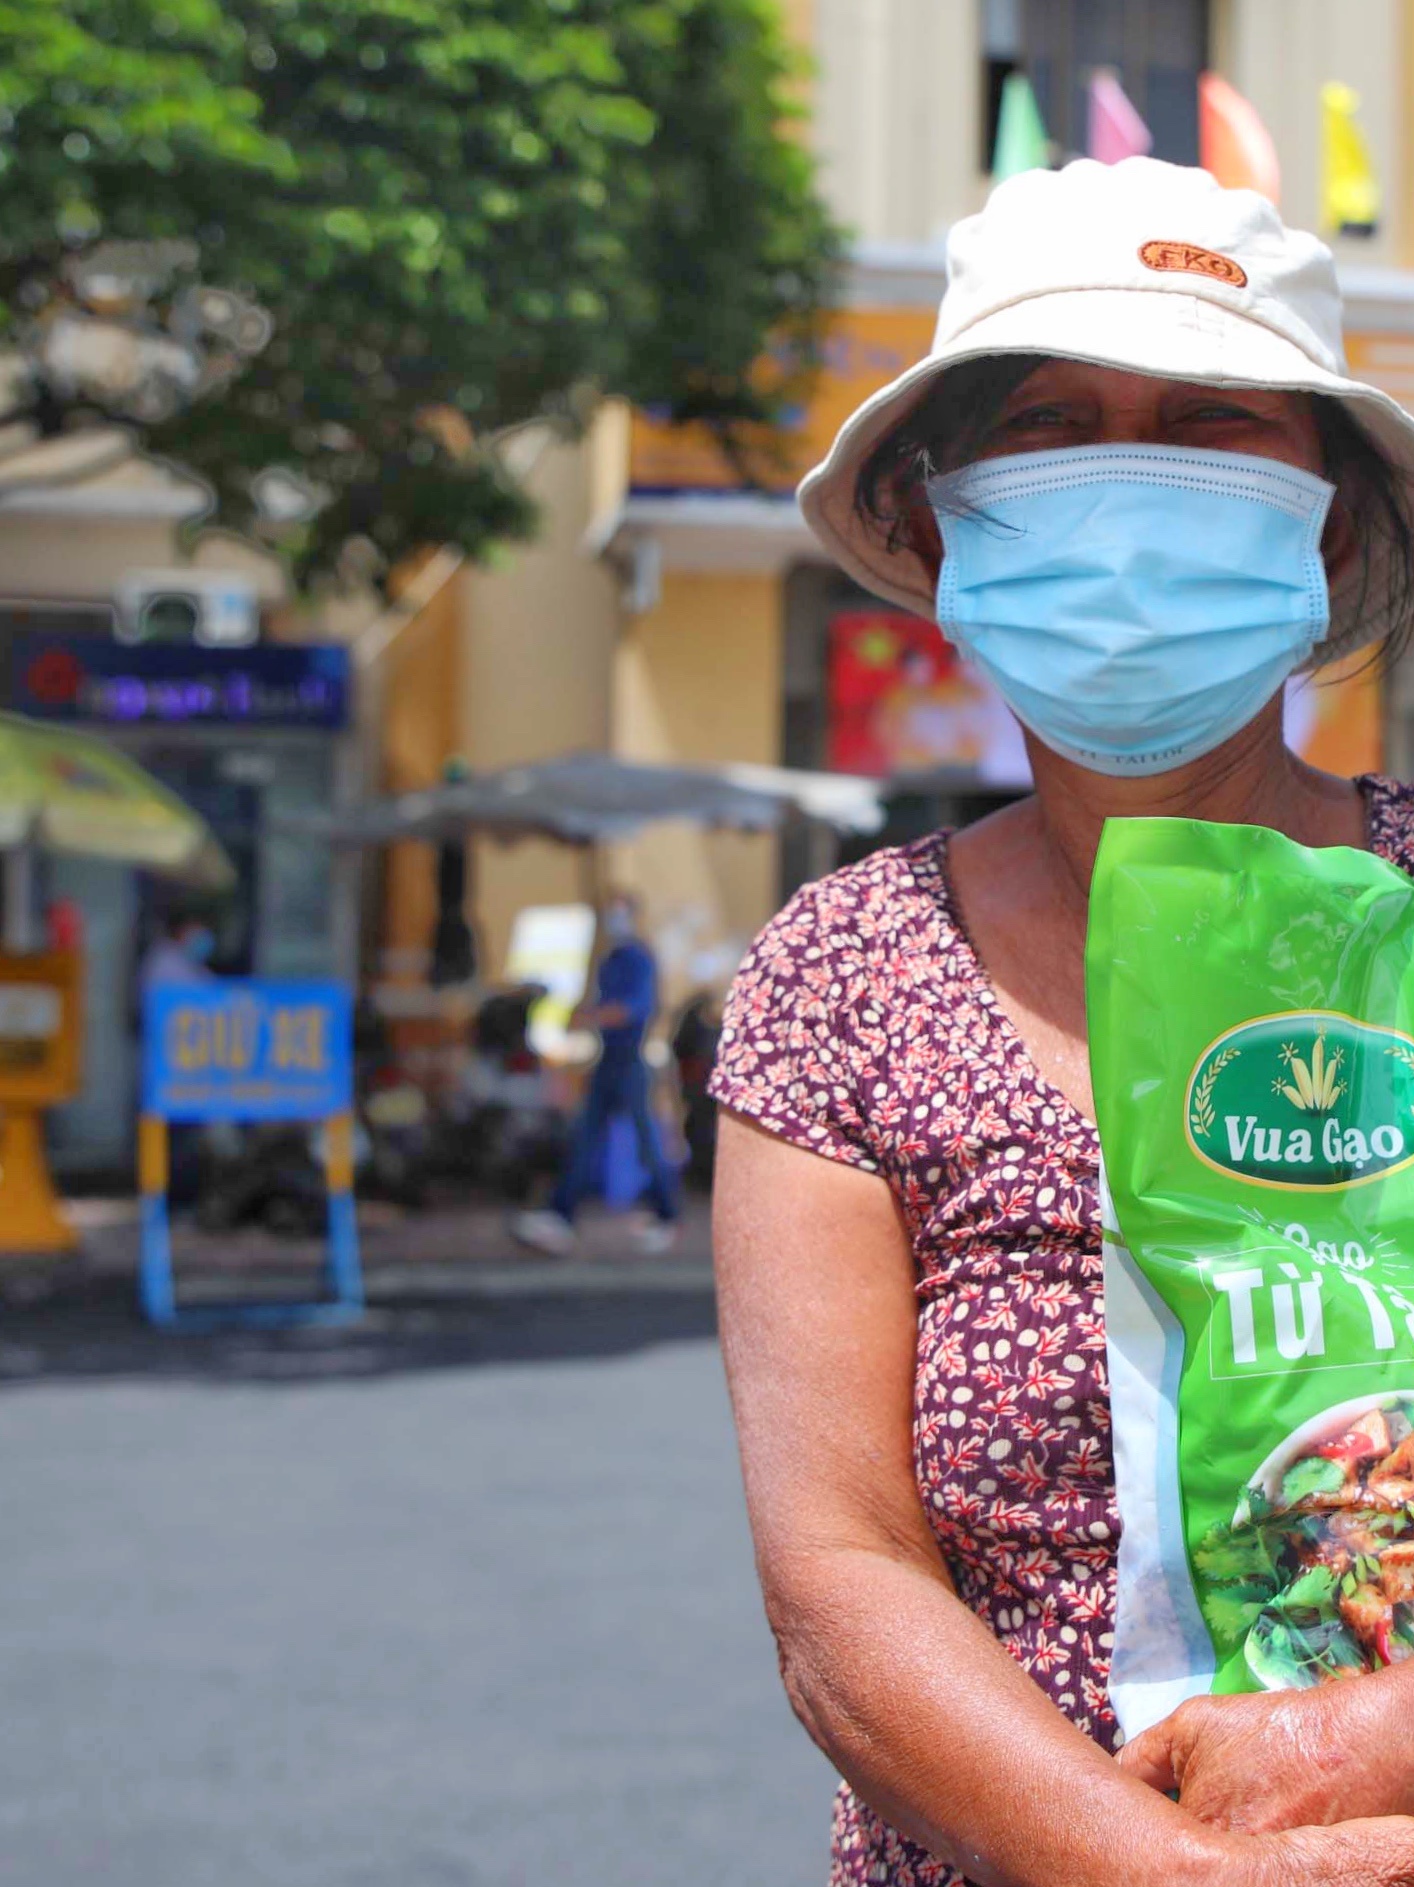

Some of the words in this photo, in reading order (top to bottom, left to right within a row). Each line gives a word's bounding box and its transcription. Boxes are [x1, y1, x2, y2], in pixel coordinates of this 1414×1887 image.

[1224, 1115, 1314, 1163] Vua
[1322, 1117, 1405, 1169] Gạo
[1212, 1262, 1326, 1364] Từ
